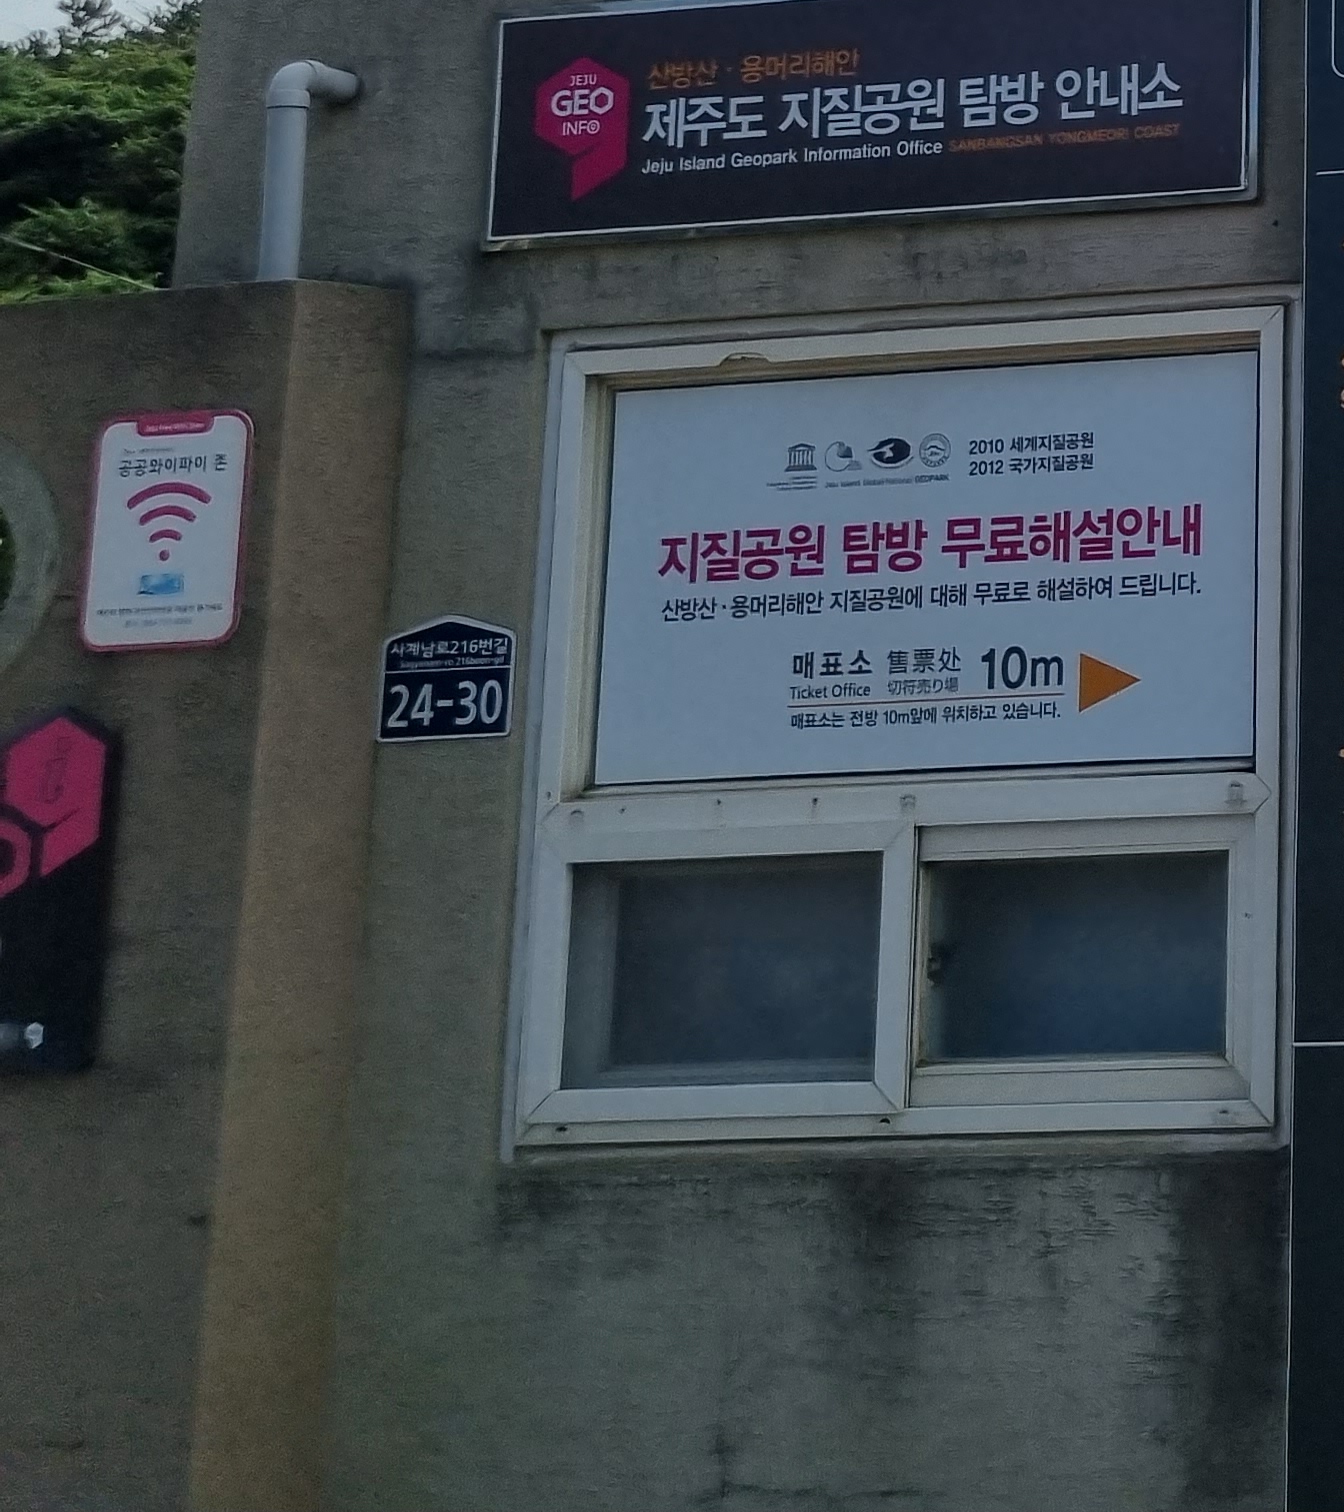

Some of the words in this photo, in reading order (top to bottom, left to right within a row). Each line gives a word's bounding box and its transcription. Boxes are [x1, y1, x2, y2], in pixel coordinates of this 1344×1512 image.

[569, 74, 597, 87] JEJU
[740, 48, 860, 84] 용머리해안
[550, 87, 614, 117] GEO
[641, 95, 768, 149] 제주도
[778, 78, 945, 139] 지질공원
[958, 70, 1045, 128] 탐방
[1055, 61, 1184, 120] 안내소
[562, 119, 600, 136] INFO
[641, 158, 674, 175] Jeju
[679, 154, 725, 172] Island
[730, 146, 798, 170] Geopark
[803, 141, 891, 163] Information
[896, 139, 943, 158] Office
[1134, 122, 1181, 140] COAST
[969, 439, 1004, 455] 2010
[1010, 432, 1094, 453] 세계지질공원
[118, 455, 207, 478] 공공와이파이
[969, 460, 1004, 476] 2012
[1009, 453, 1094, 474] 국가지질공원
[658, 524, 825, 583] 지질공원
[843, 519, 928, 574] 탐방
[941, 503, 1201, 569] 무료해설안내
[661, 597, 717, 622] 산방산
[730, 591, 824, 620] 용머리해안
[829, 585, 923, 613] 지질공원에
[930, 583, 967, 607] 대해
[973, 581, 1031, 606] 무료로
[1037, 575, 1112, 602] 해설하여
[1119, 571, 1201, 597] 드립니다.
[391, 637, 508, 658] 사계남로216번길
[886, 646, 962, 675] 售票处
[793, 649, 873, 679] 매표소
[981, 645, 1064, 690] 10m
[387, 679, 503, 728] 24-30
[789, 686, 828, 700] Ticket
[831, 683, 871, 699] Office
[791, 710, 846, 730] 매표소는
[850, 710, 878, 728] 전방
[883, 707, 937, 725] 10m앞에
[941, 703, 997, 723] 위치하고
[1002, 701, 1061, 721] 있습니다.
